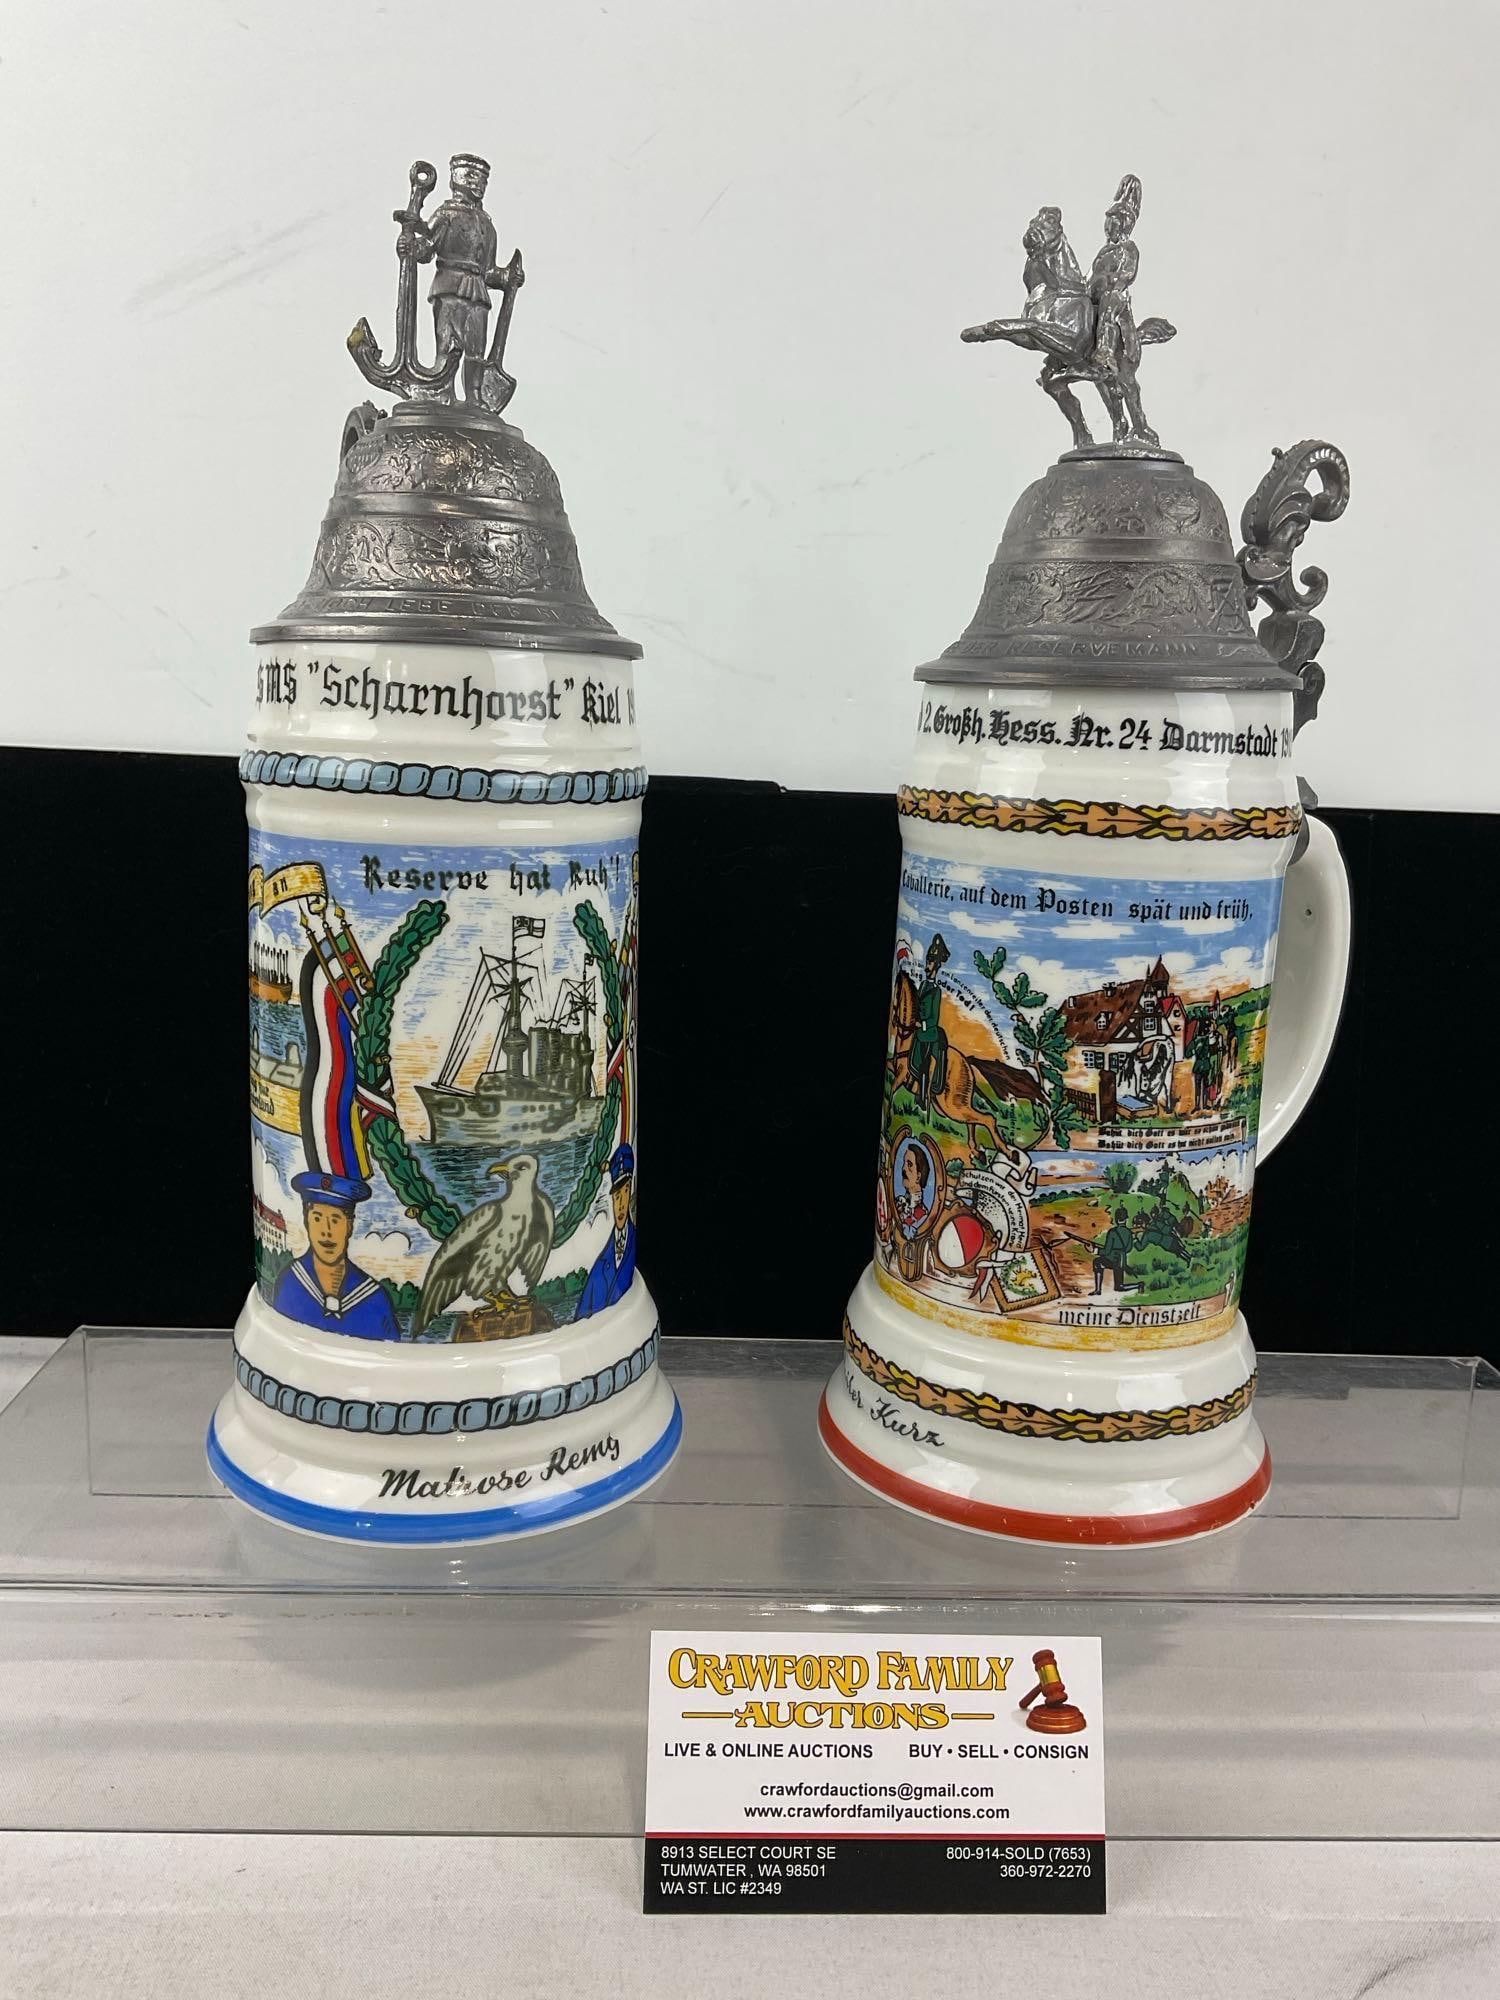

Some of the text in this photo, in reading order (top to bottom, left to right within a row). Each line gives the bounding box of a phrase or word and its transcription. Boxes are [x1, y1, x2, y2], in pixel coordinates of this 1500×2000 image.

[386, 599, 450, 613] LEBE
[581, 676, 621, 731] Kiel
[988, 709, 1062, 747] Hess.
[1063, 712, 1114, 748] Nr.
[1119, 717, 1152, 751] 24
[1159, 717, 1278, 758] Darmstadt
[360, 854, 489, 896] Reserve
[508, 861, 551, 896] hat
[959, 886, 986, 905] auf
[990, 888, 1027, 910] dem
[1034, 887, 1112, 917] Posten
[1128, 898, 1173, 923] spät
[1179, 901, 1212, 920] und
[937, 979, 955, 994] oder
[1059, 1306, 1112, 1326] meine
[870, 1397, 945, 1447] Kurz
[668, 1647, 1013, 1696] CRAWFORD FAMILY
[734, 1701, 950, 1730] AUCTIONS
[665, 1743, 873, 1759] LIVE & ONLINE AUCTIONS
[909, 1744, 1088, 1759] BUY SELL CONSIGN
[760, 1782, 994, 1801] crawfordauctions@gmail.com
[744, 1804, 1010, 1822] www.crawfordfamilyauctions.com
[661, 1846, 836, 1860] 8913 SELECT COURT SE
[947, 1847, 1091, 1862] 800-914-SOLD (7653)
[758, 1864, 782, 1877] WA
[786, 1864, 825, 1877] 98501
[1000, 1864, 1091, 1877] 360-972-2270
[661, 1882, 782, 1895] WA ST. LIC #2349
